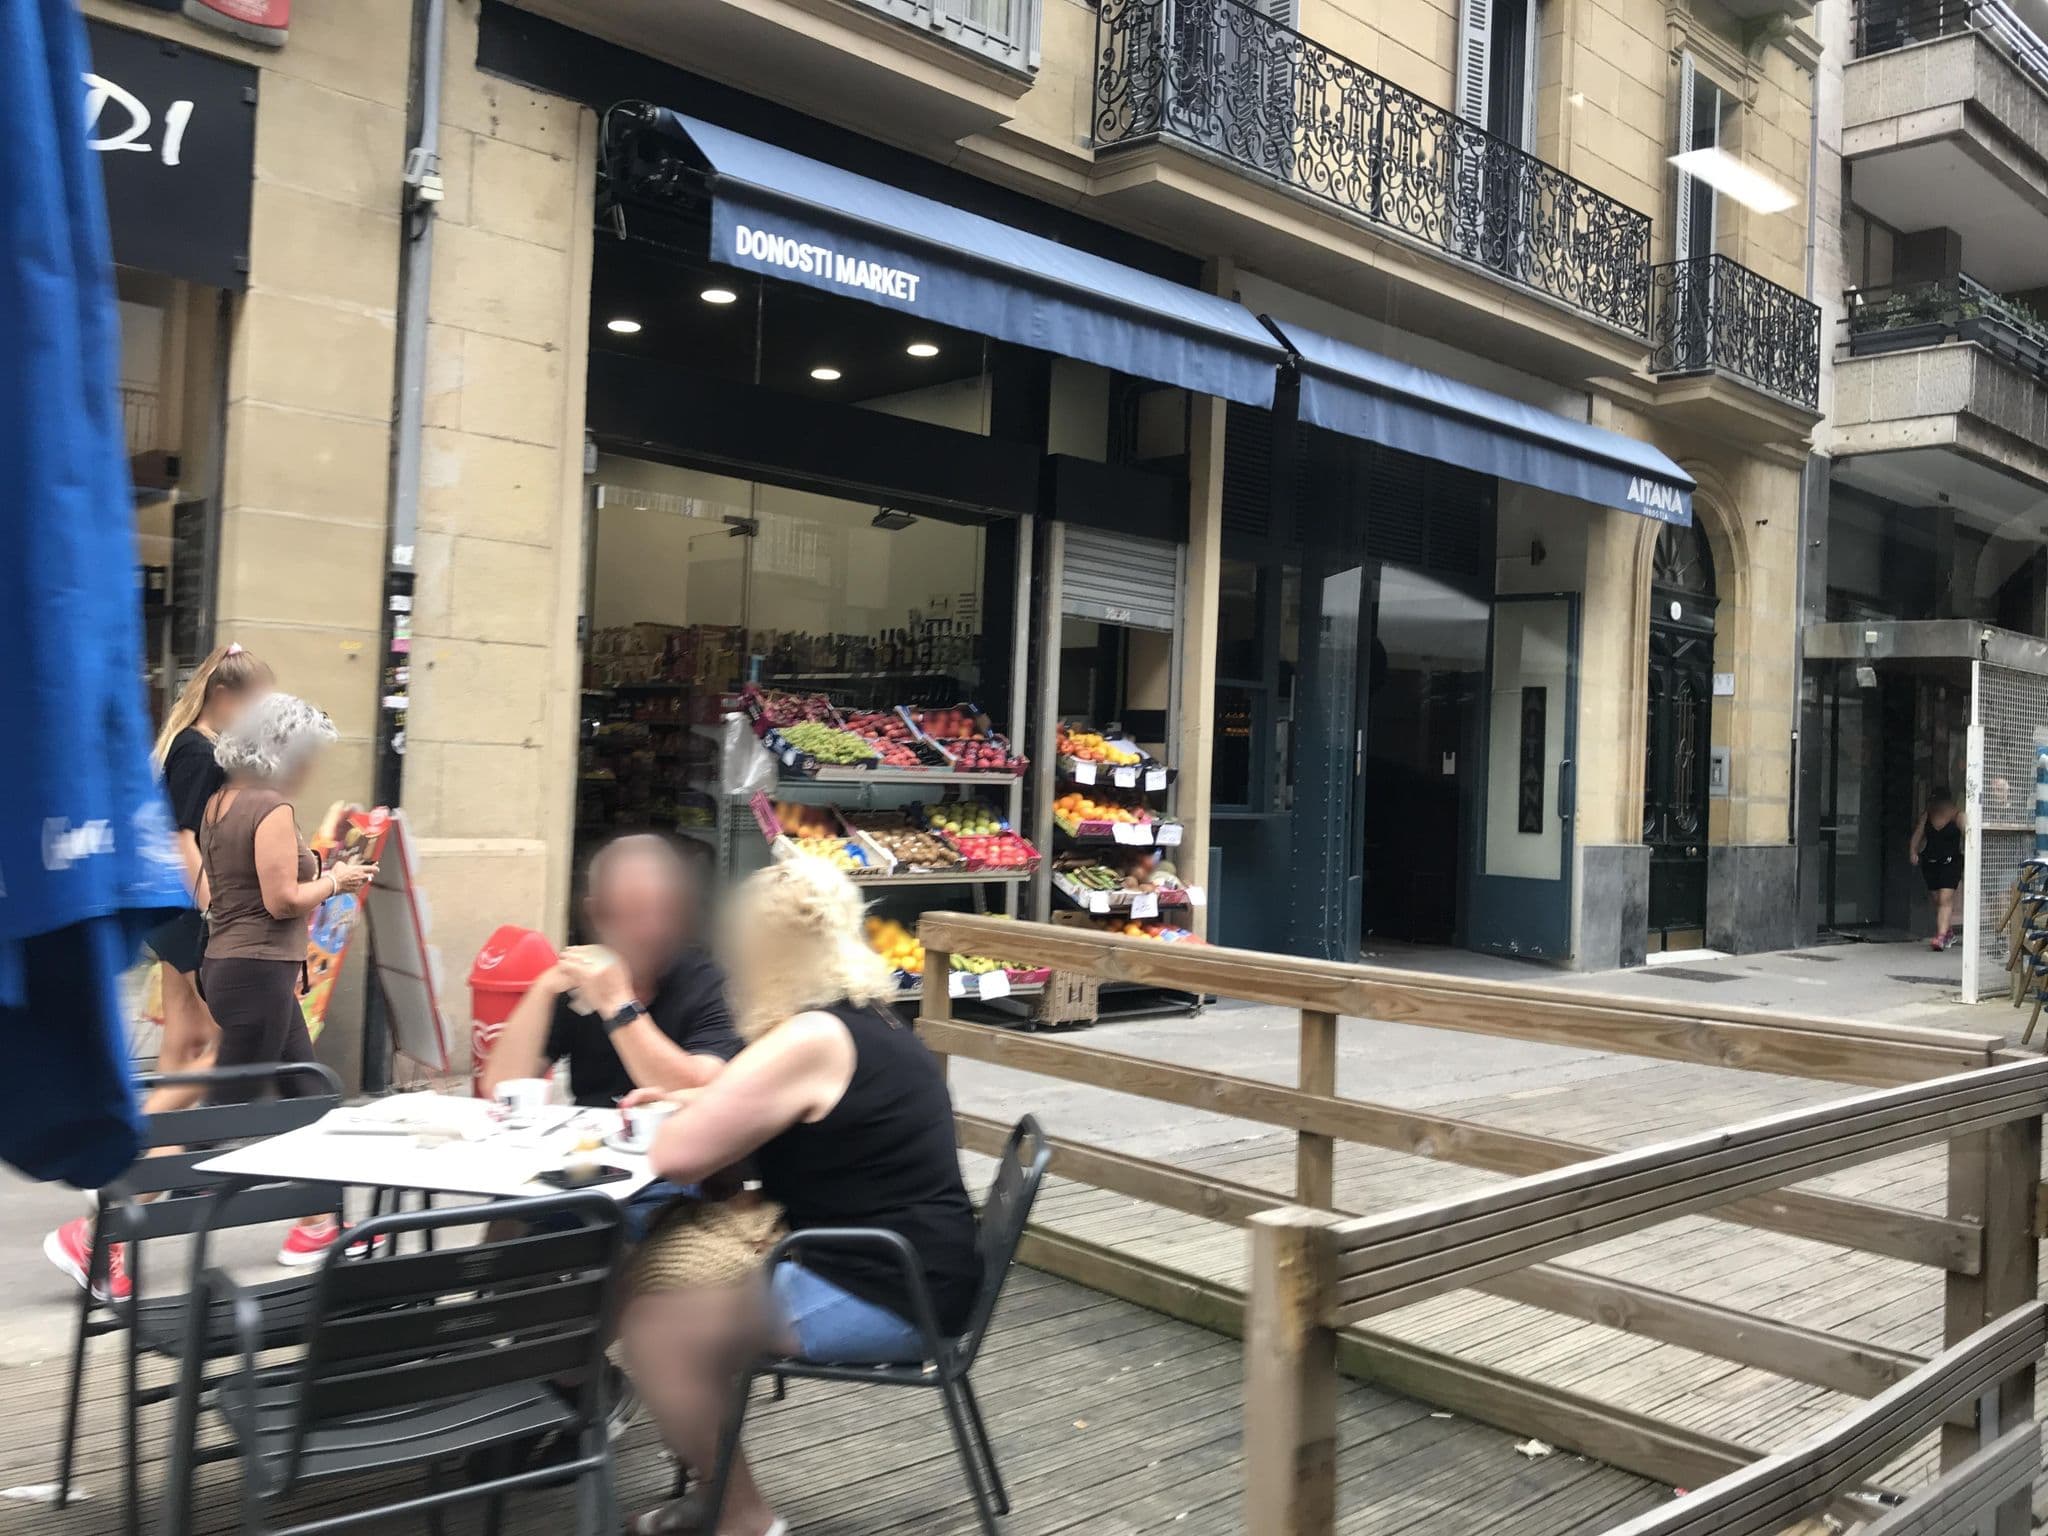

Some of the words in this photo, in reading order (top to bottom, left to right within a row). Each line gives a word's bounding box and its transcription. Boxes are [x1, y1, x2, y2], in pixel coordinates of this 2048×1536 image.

[735, 225, 832, 279] DONOSTI
[835, 254, 920, 302] MARKET
[1627, 476, 1683, 514] AITANA
